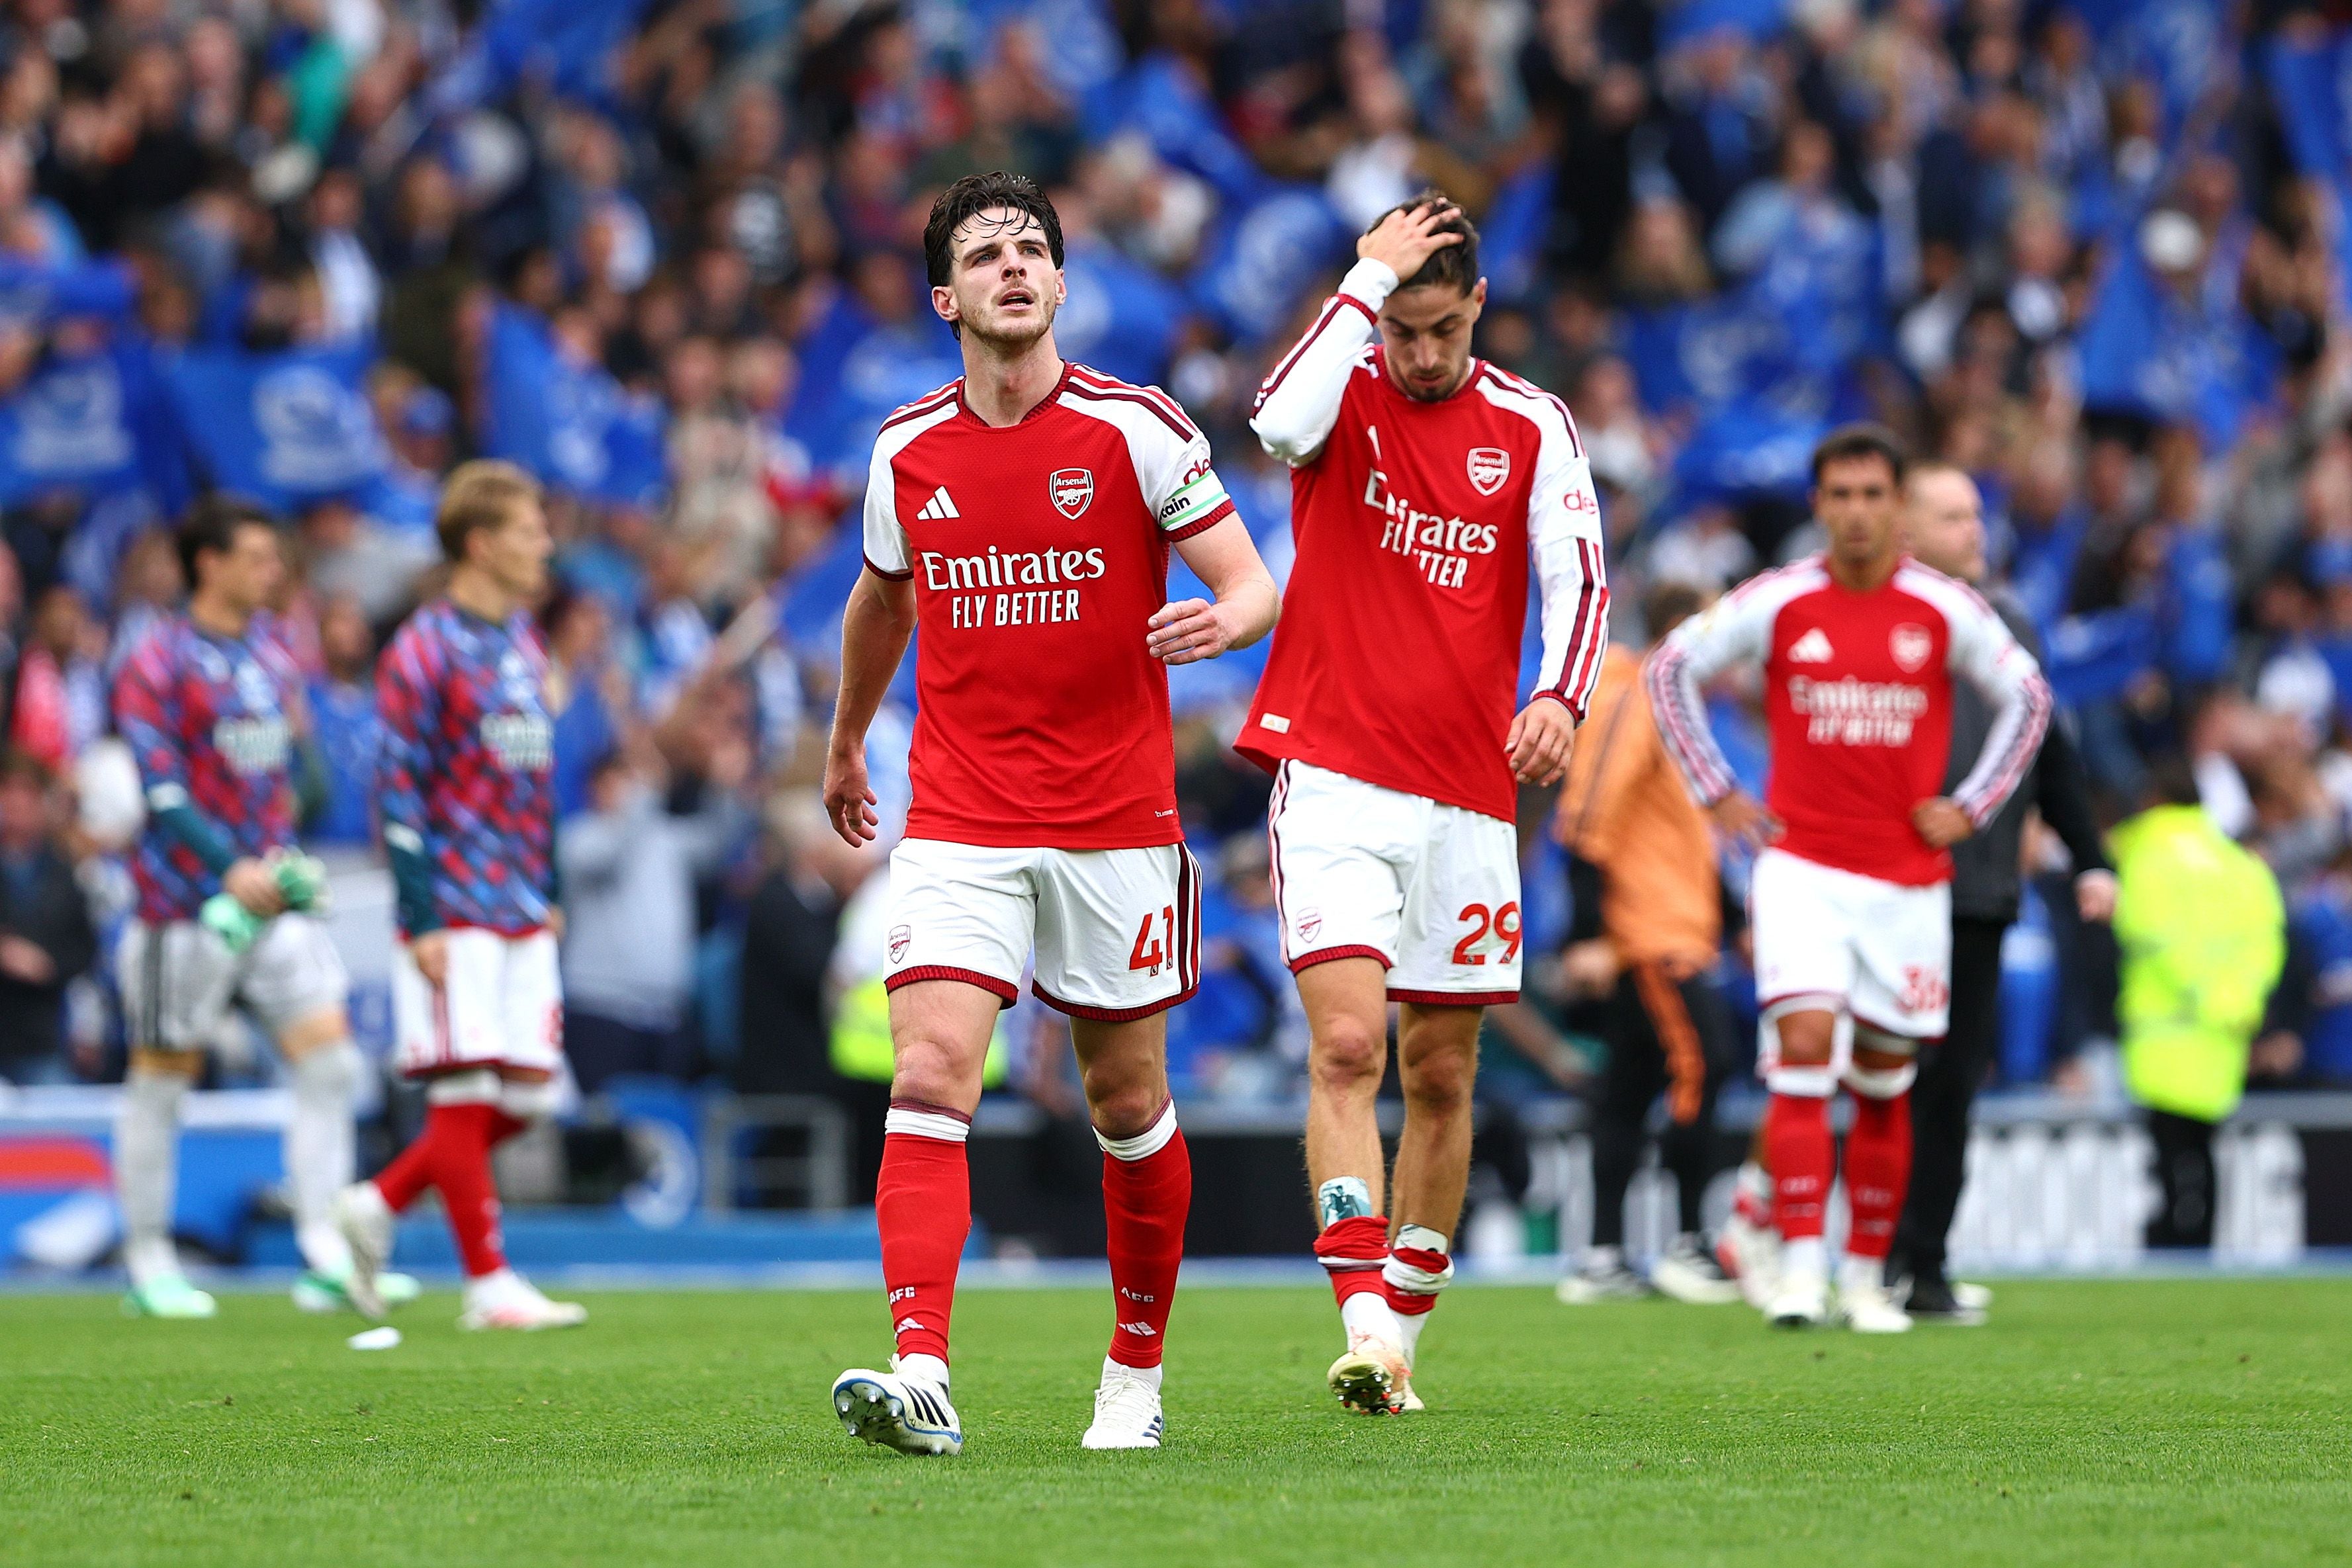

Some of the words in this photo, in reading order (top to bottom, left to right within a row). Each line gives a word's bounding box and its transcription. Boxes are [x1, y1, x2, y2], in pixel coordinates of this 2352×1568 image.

[1056, 476, 1087, 486] Arsenal
[1159, 496, 1191, 520] tain
[921, 545, 1106, 590] Emirates
[952, 595, 987, 629] FLY
[995, 589, 1079, 626] BETTER
[1129, 904, 1174, 977] 41
[1453, 901, 1522, 965] 29
